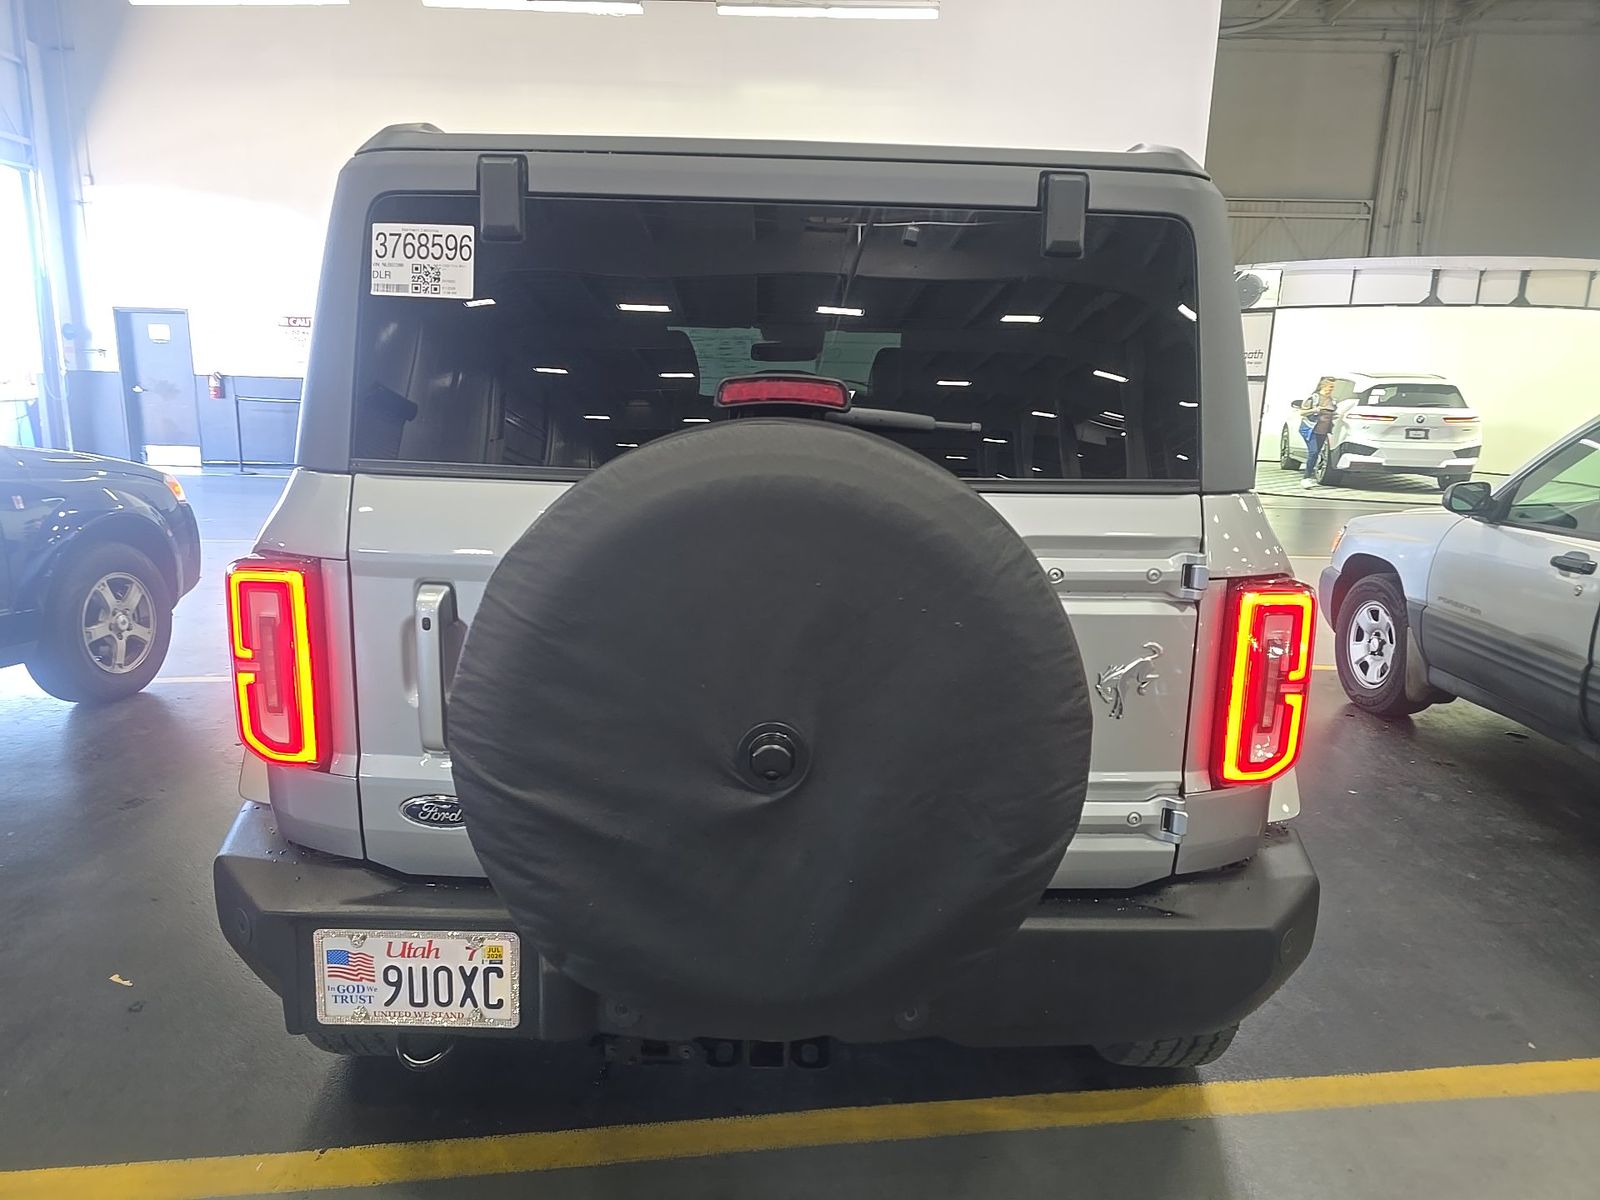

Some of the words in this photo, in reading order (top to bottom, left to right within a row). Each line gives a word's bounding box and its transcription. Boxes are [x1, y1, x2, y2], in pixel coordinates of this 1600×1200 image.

[375, 232, 473, 262] 3768596
[373, 270, 392, 279] DLR
[418, 802, 463, 822] Ford
[386, 940, 441, 959] Utah
[336, 984, 366, 994] GOD
[331, 994, 375, 1004] TRUST
[373, 1010, 412, 1019] UNITED
[413, 1011, 429, 1019] WE
[430, 1011, 465, 1020] STAND
